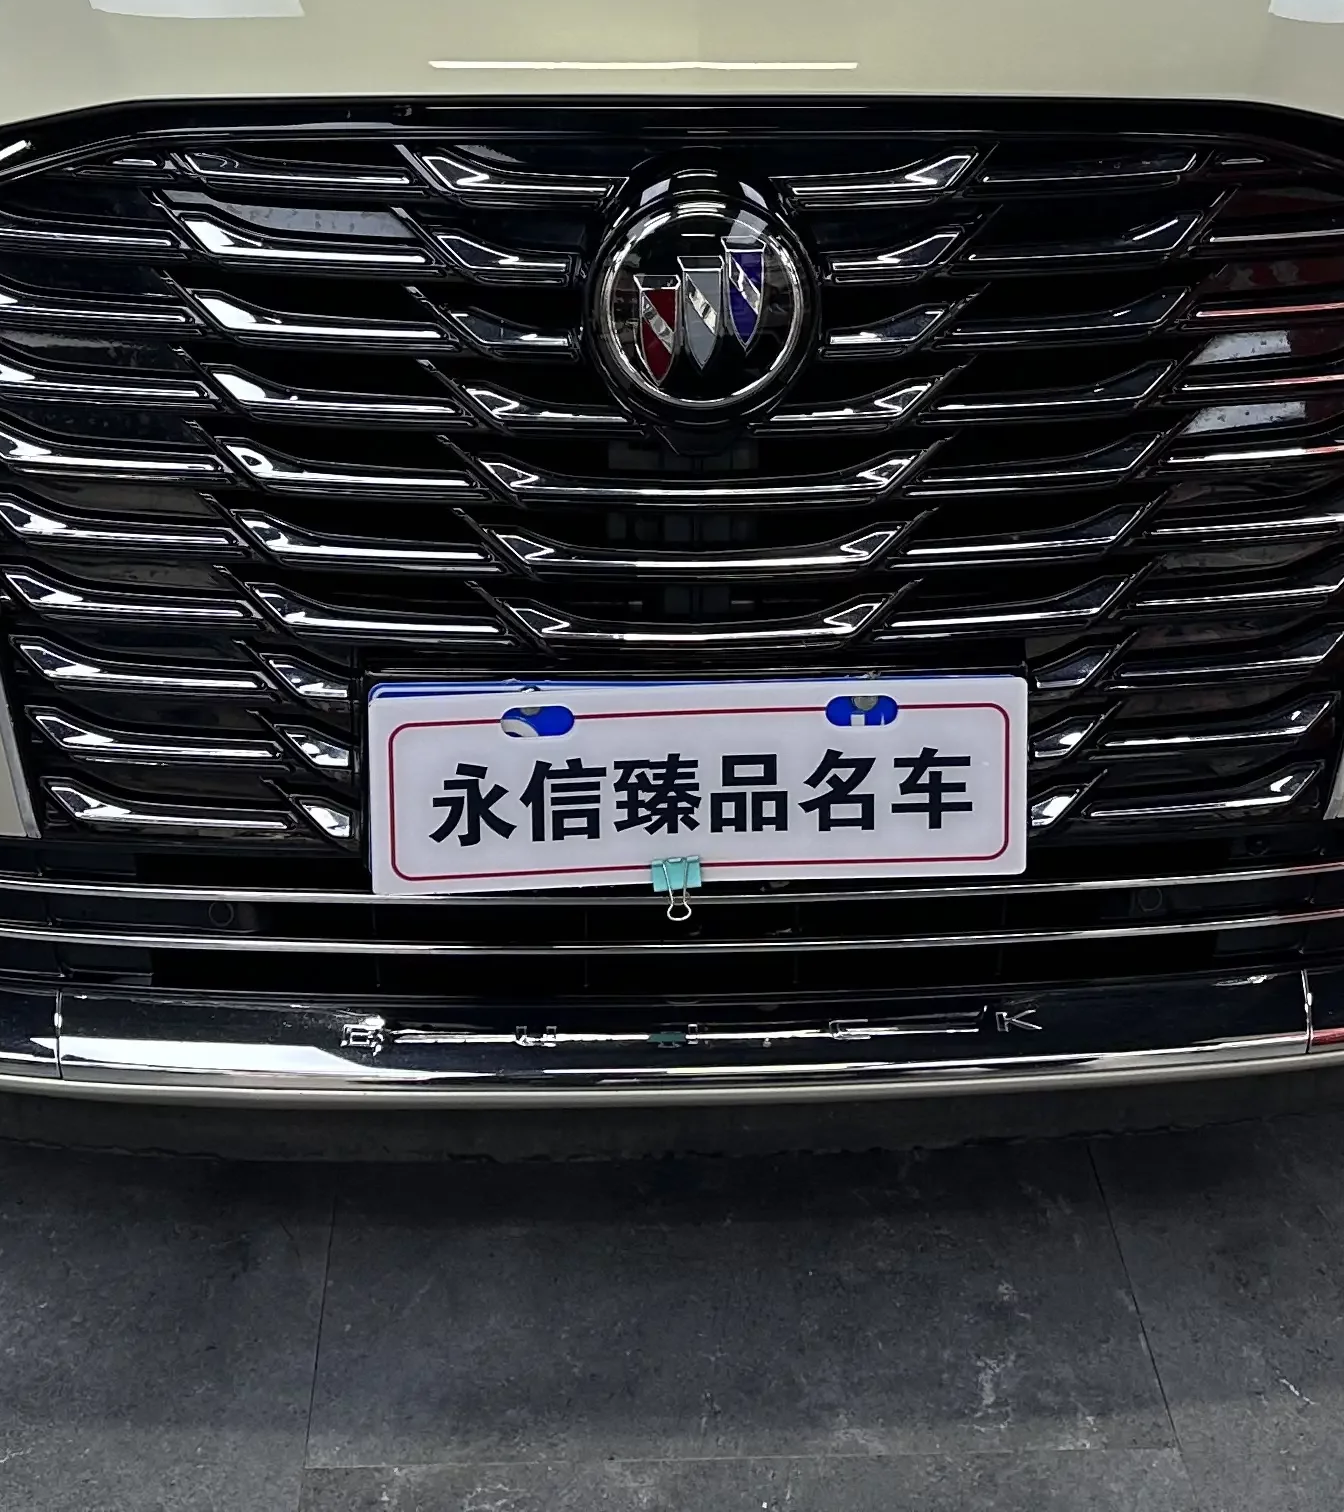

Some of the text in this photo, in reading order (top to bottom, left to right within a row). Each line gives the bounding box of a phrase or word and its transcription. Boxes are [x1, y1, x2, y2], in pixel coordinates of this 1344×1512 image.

[430, 746, 974, 848] 永信臻品名车
